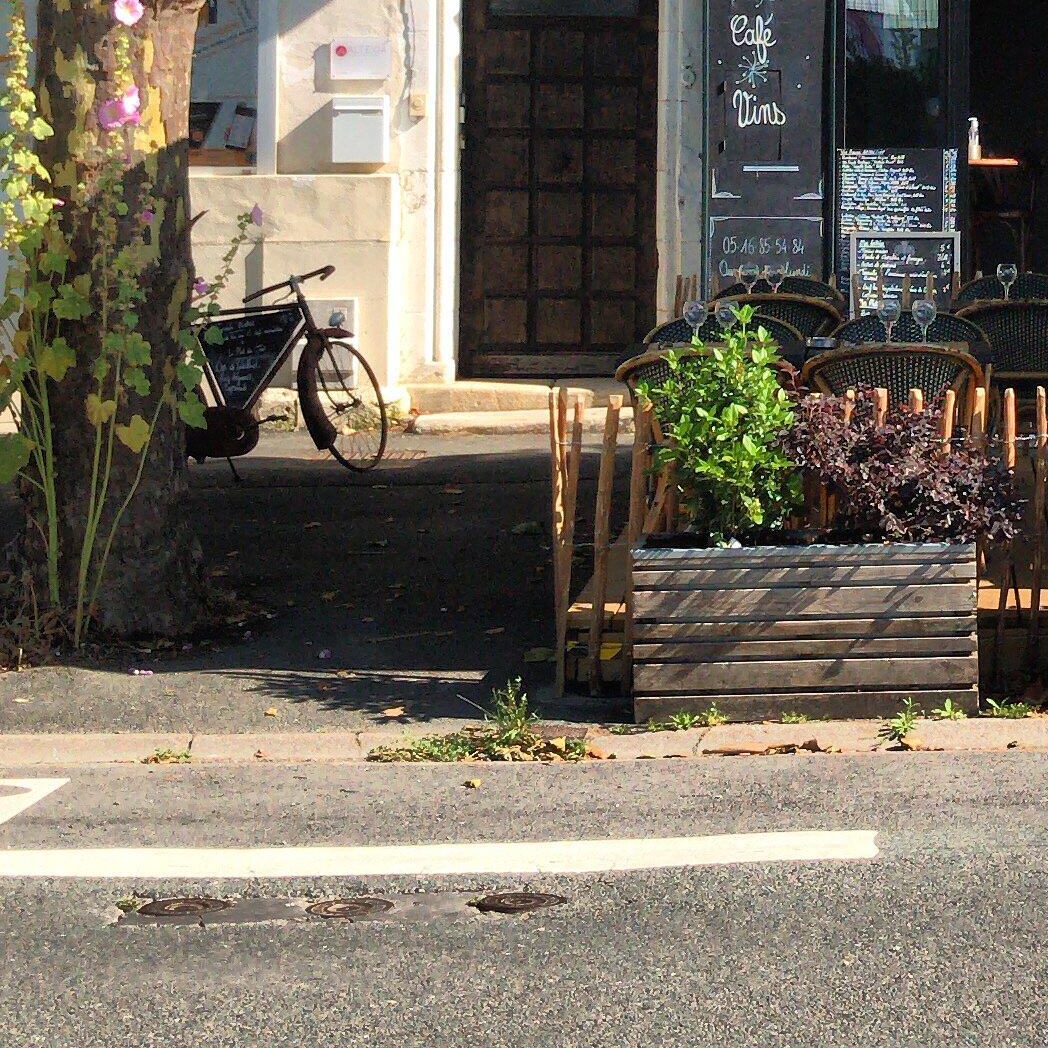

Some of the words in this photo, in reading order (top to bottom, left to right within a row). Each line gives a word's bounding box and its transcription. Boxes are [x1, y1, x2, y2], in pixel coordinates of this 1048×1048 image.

[730, 13, 776, 65] Café
[732, 89, 787, 128] Vins
[722, 235, 738, 255] 05
[740, 237, 755, 255] 16
